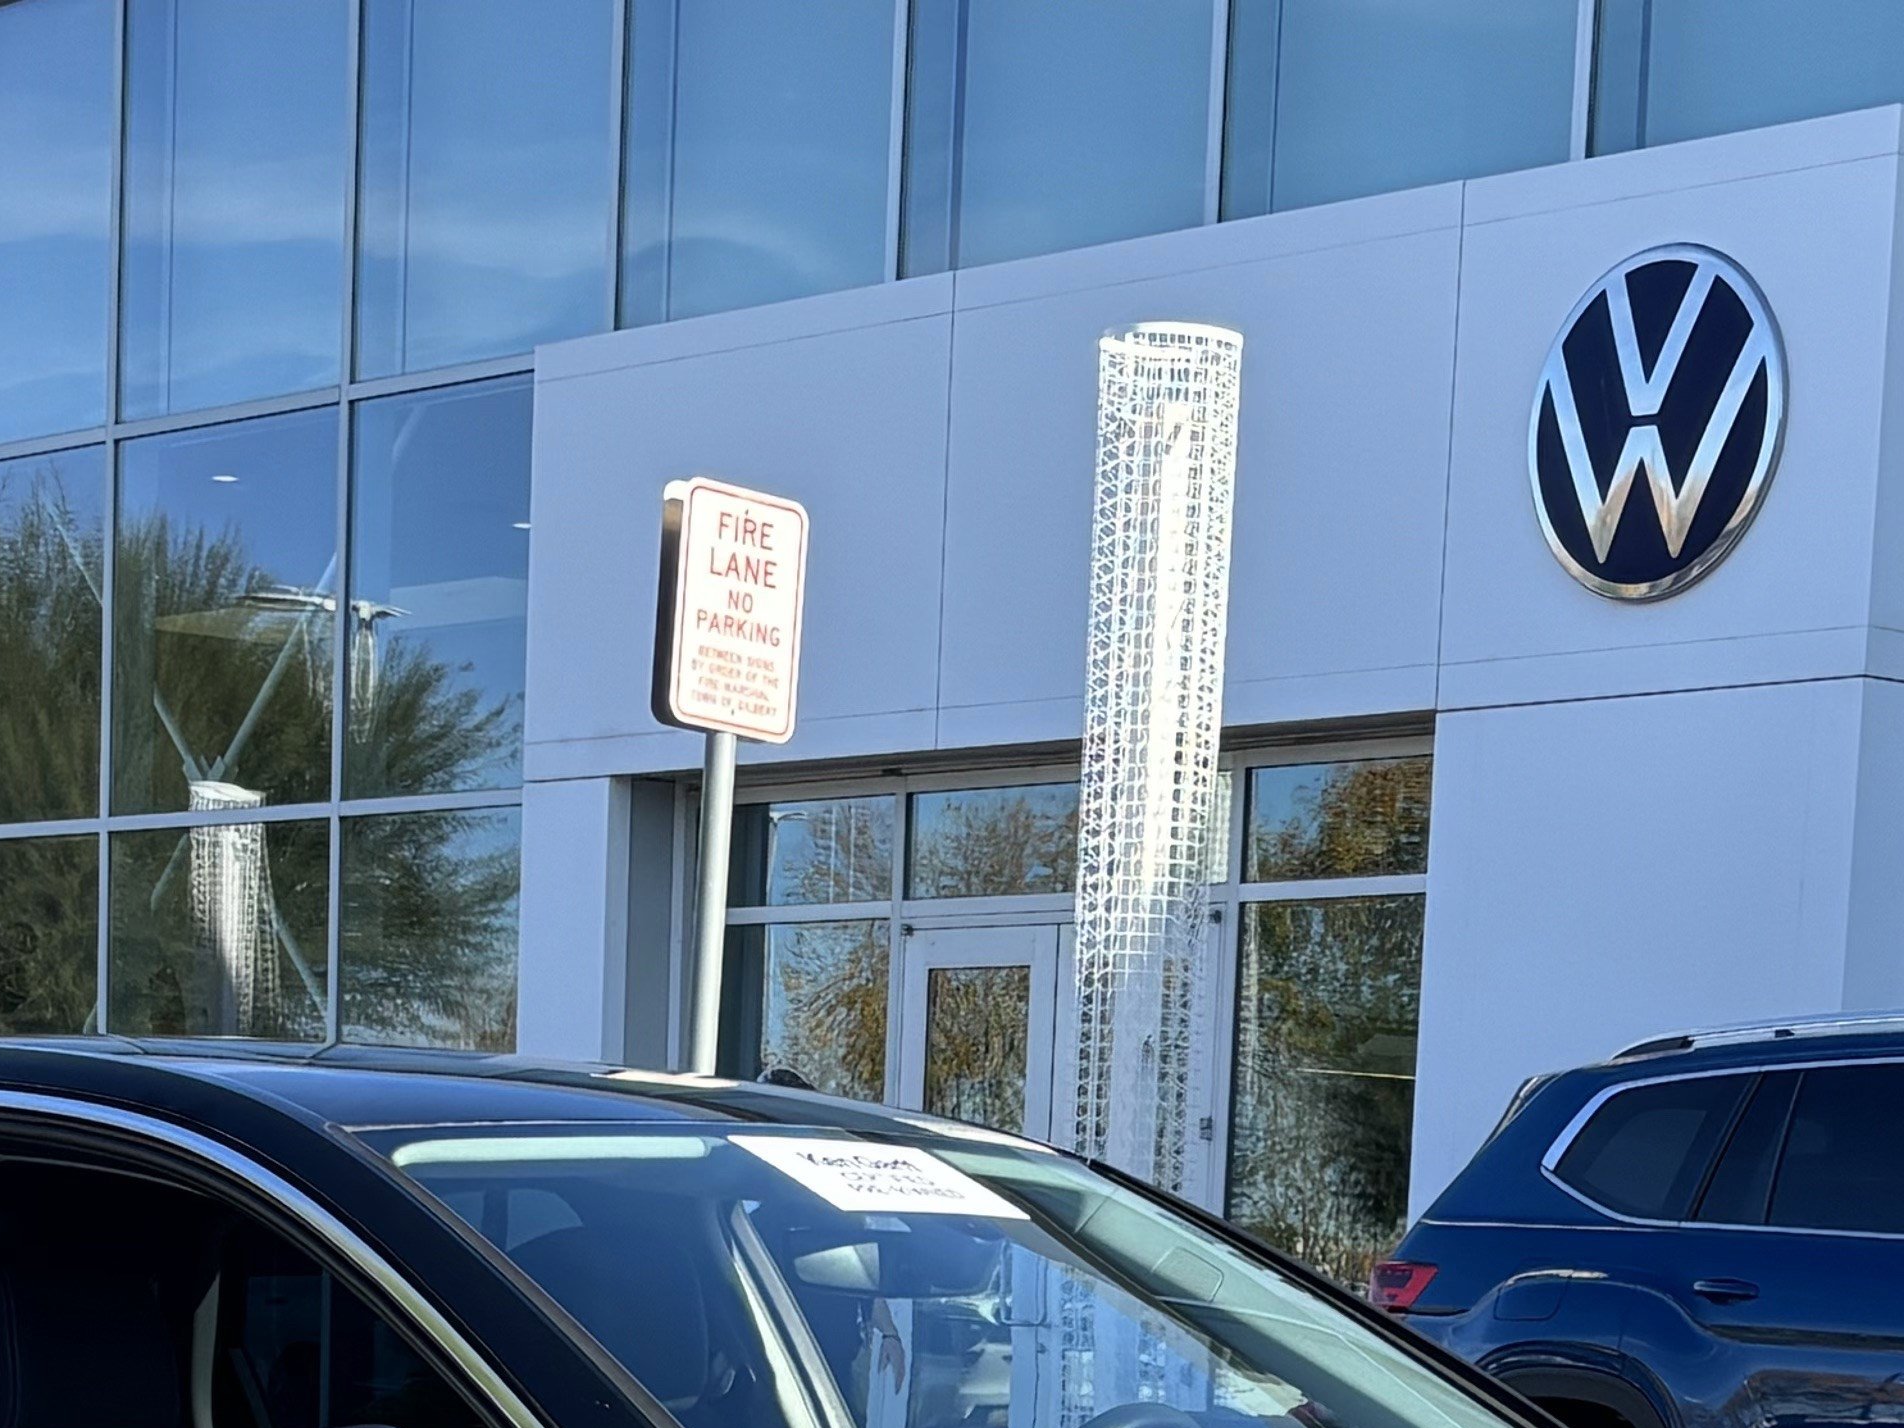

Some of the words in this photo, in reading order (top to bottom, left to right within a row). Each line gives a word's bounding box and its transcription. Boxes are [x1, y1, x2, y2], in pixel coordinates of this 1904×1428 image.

[1530, 244, 1788, 600] VW
[718, 512, 774, 551] FIRE
[709, 547, 777, 589] LANE
[727, 589, 753, 613] NO
[696, 609, 780, 647] PARKING
